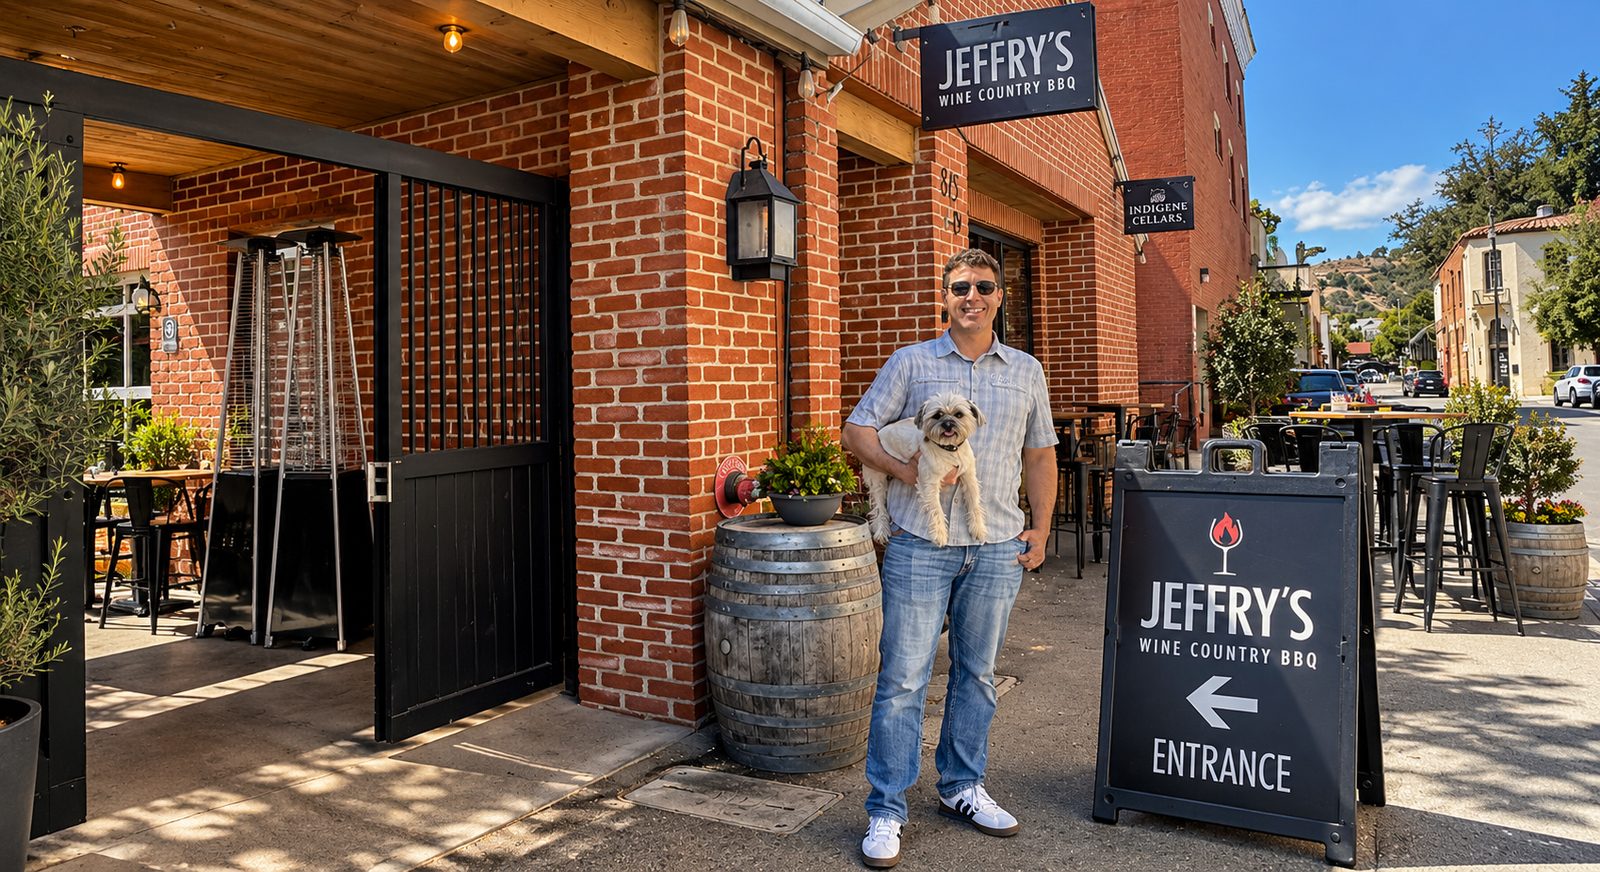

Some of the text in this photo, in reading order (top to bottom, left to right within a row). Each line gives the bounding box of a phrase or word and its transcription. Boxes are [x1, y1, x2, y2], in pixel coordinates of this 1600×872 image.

[938, 30, 1074, 90] JEFFRY'S
[939, 76, 1076, 107] WINE COUNTRY BBQ
[1129, 202, 1188, 215] INDIGENE
[1140, 581, 1314, 642] JEFFRY'S
[1139, 638, 1317, 670] WINE COUNTRY BBQ
[1152, 738, 1292, 793] ENTRANCE
